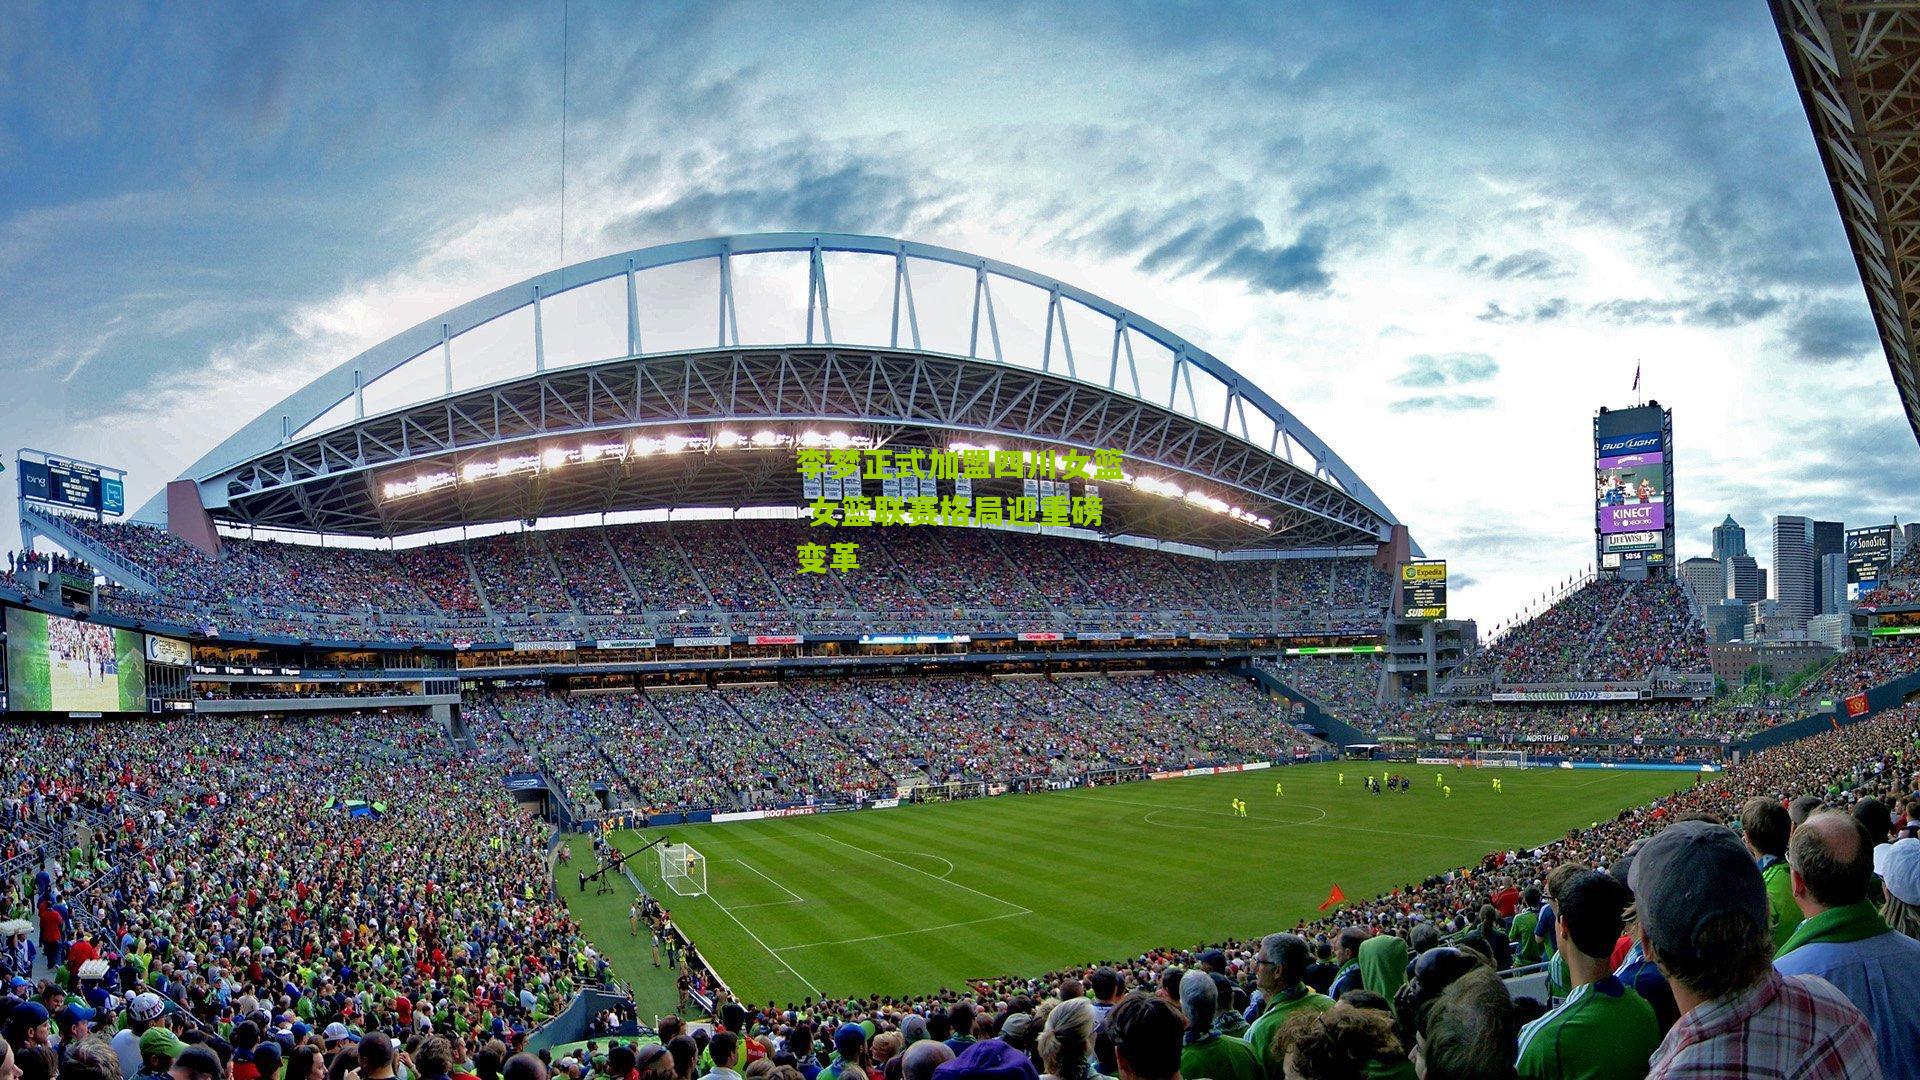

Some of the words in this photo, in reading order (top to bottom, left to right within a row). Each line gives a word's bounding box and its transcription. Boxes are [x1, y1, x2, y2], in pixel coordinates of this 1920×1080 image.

[1602, 442, 1624, 451] BUD
[1628, 438, 1658, 447] LIGHT
[26, 474, 46, 487] bing
[1613, 507, 1653, 519] KINECT
[1858, 536, 1887, 549] SonoSite
[1417, 569, 1442, 577] Expedia
[1405, 608, 1444, 617] SUBWAY
[518, 642, 565, 650] PINNACLE
[1553, 734, 1569, 742] END
[764, 809, 787, 818] ROOT
